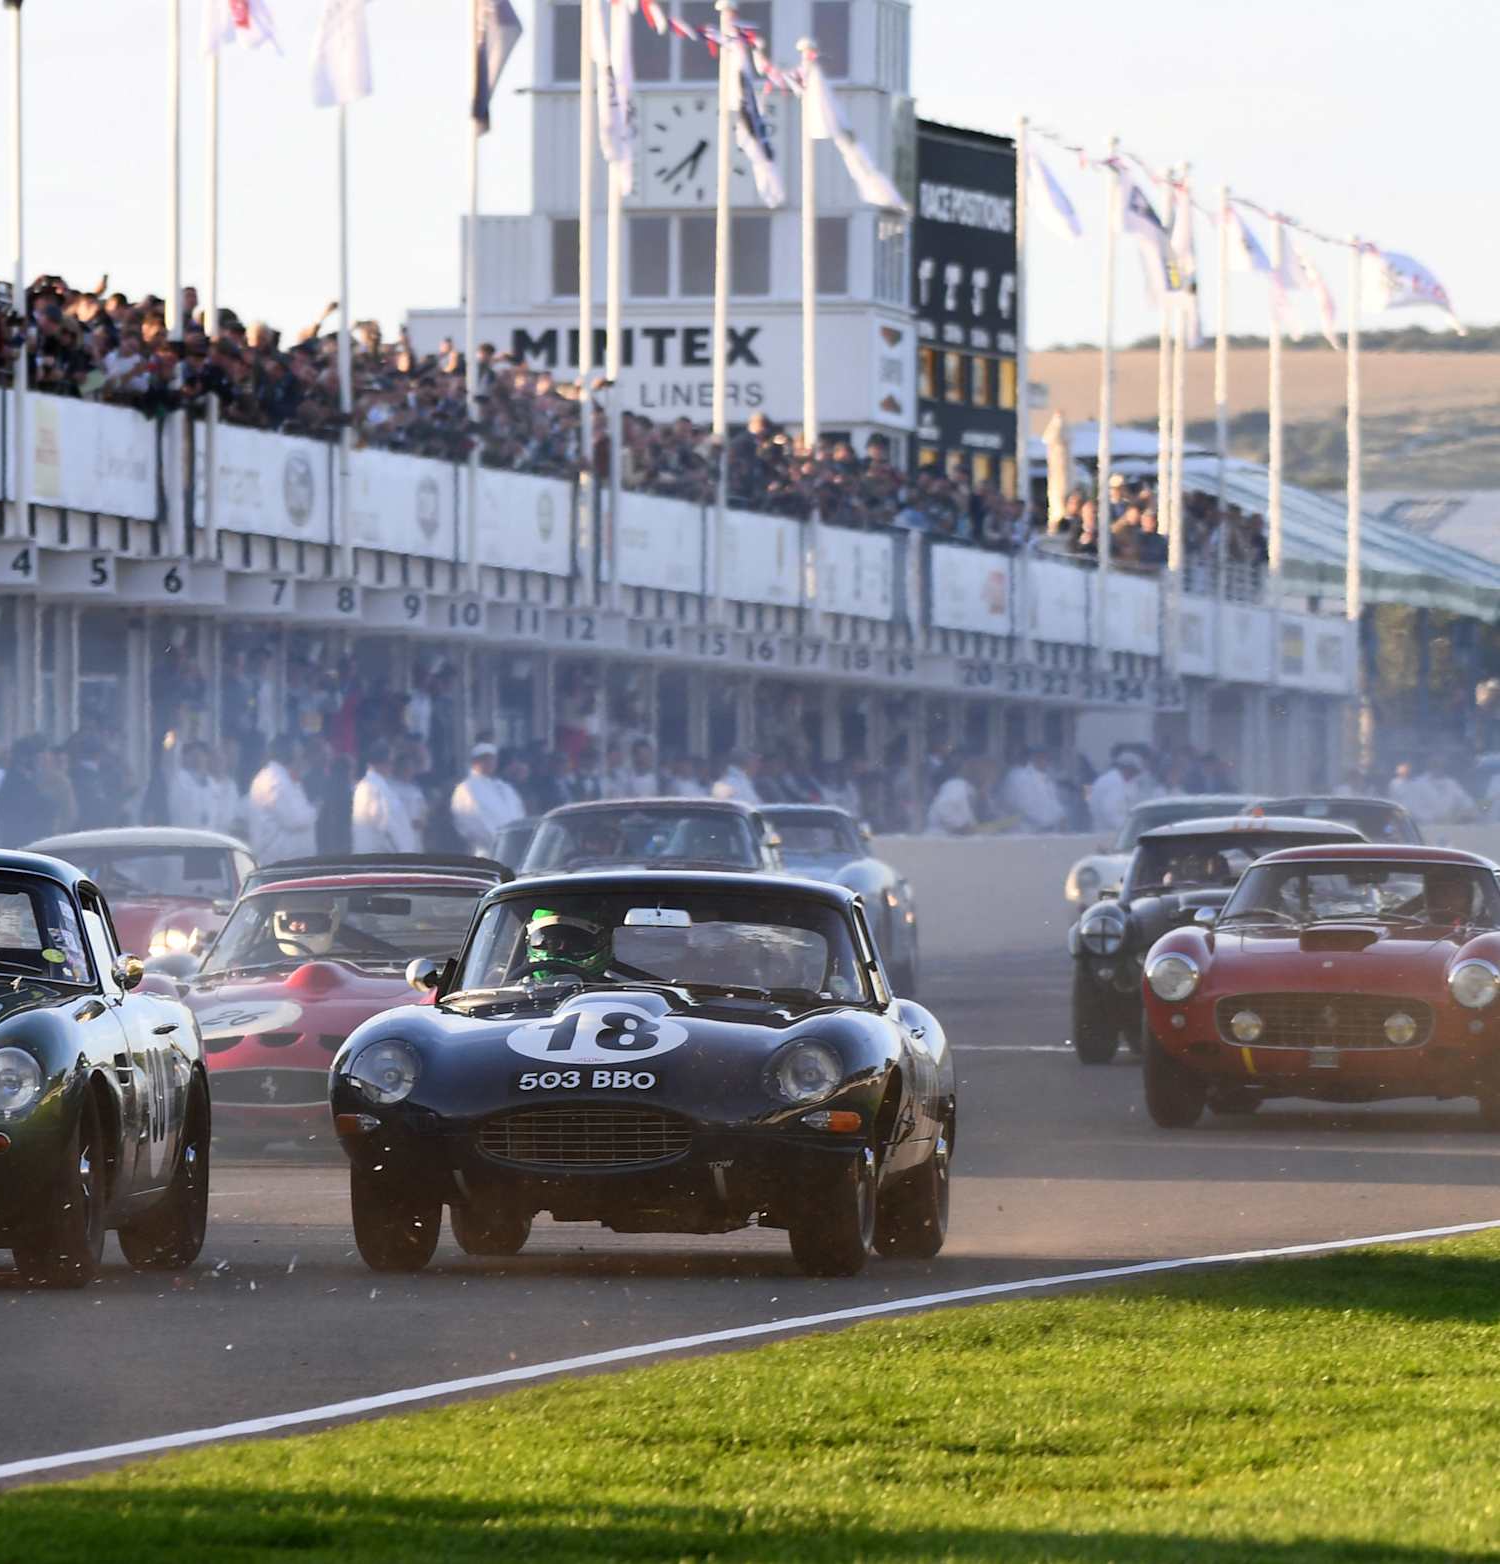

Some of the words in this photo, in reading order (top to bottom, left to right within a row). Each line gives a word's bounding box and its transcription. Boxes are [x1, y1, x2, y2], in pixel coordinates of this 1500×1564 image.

[512, 326, 761, 368] MINTEX
[640, 382, 764, 408] LINERS
[10, 547, 32, 577] 4
[91, 556, 108, 587] 5
[163, 566, 182, 594] 6
[270, 578, 288, 606] 7
[336, 586, 354, 613] 8
[403, 594, 420, 619] 9
[449, 602, 480, 628] 10
[515, 608, 541, 634] 11
[565, 615, 596, 641] 12
[645, 626, 674, 650] 14
[699, 632, 726, 656] 15
[747, 636, 774, 662] 16
[795, 640, 822, 665] 17
[200, 1009, 271, 1026] 26
[539, 1011, 661, 1051] 18
[518, 1070, 581, 1091] 503
[591, 1070, 656, 1090] BBO
[707, 1159, 734, 1169] TOW
